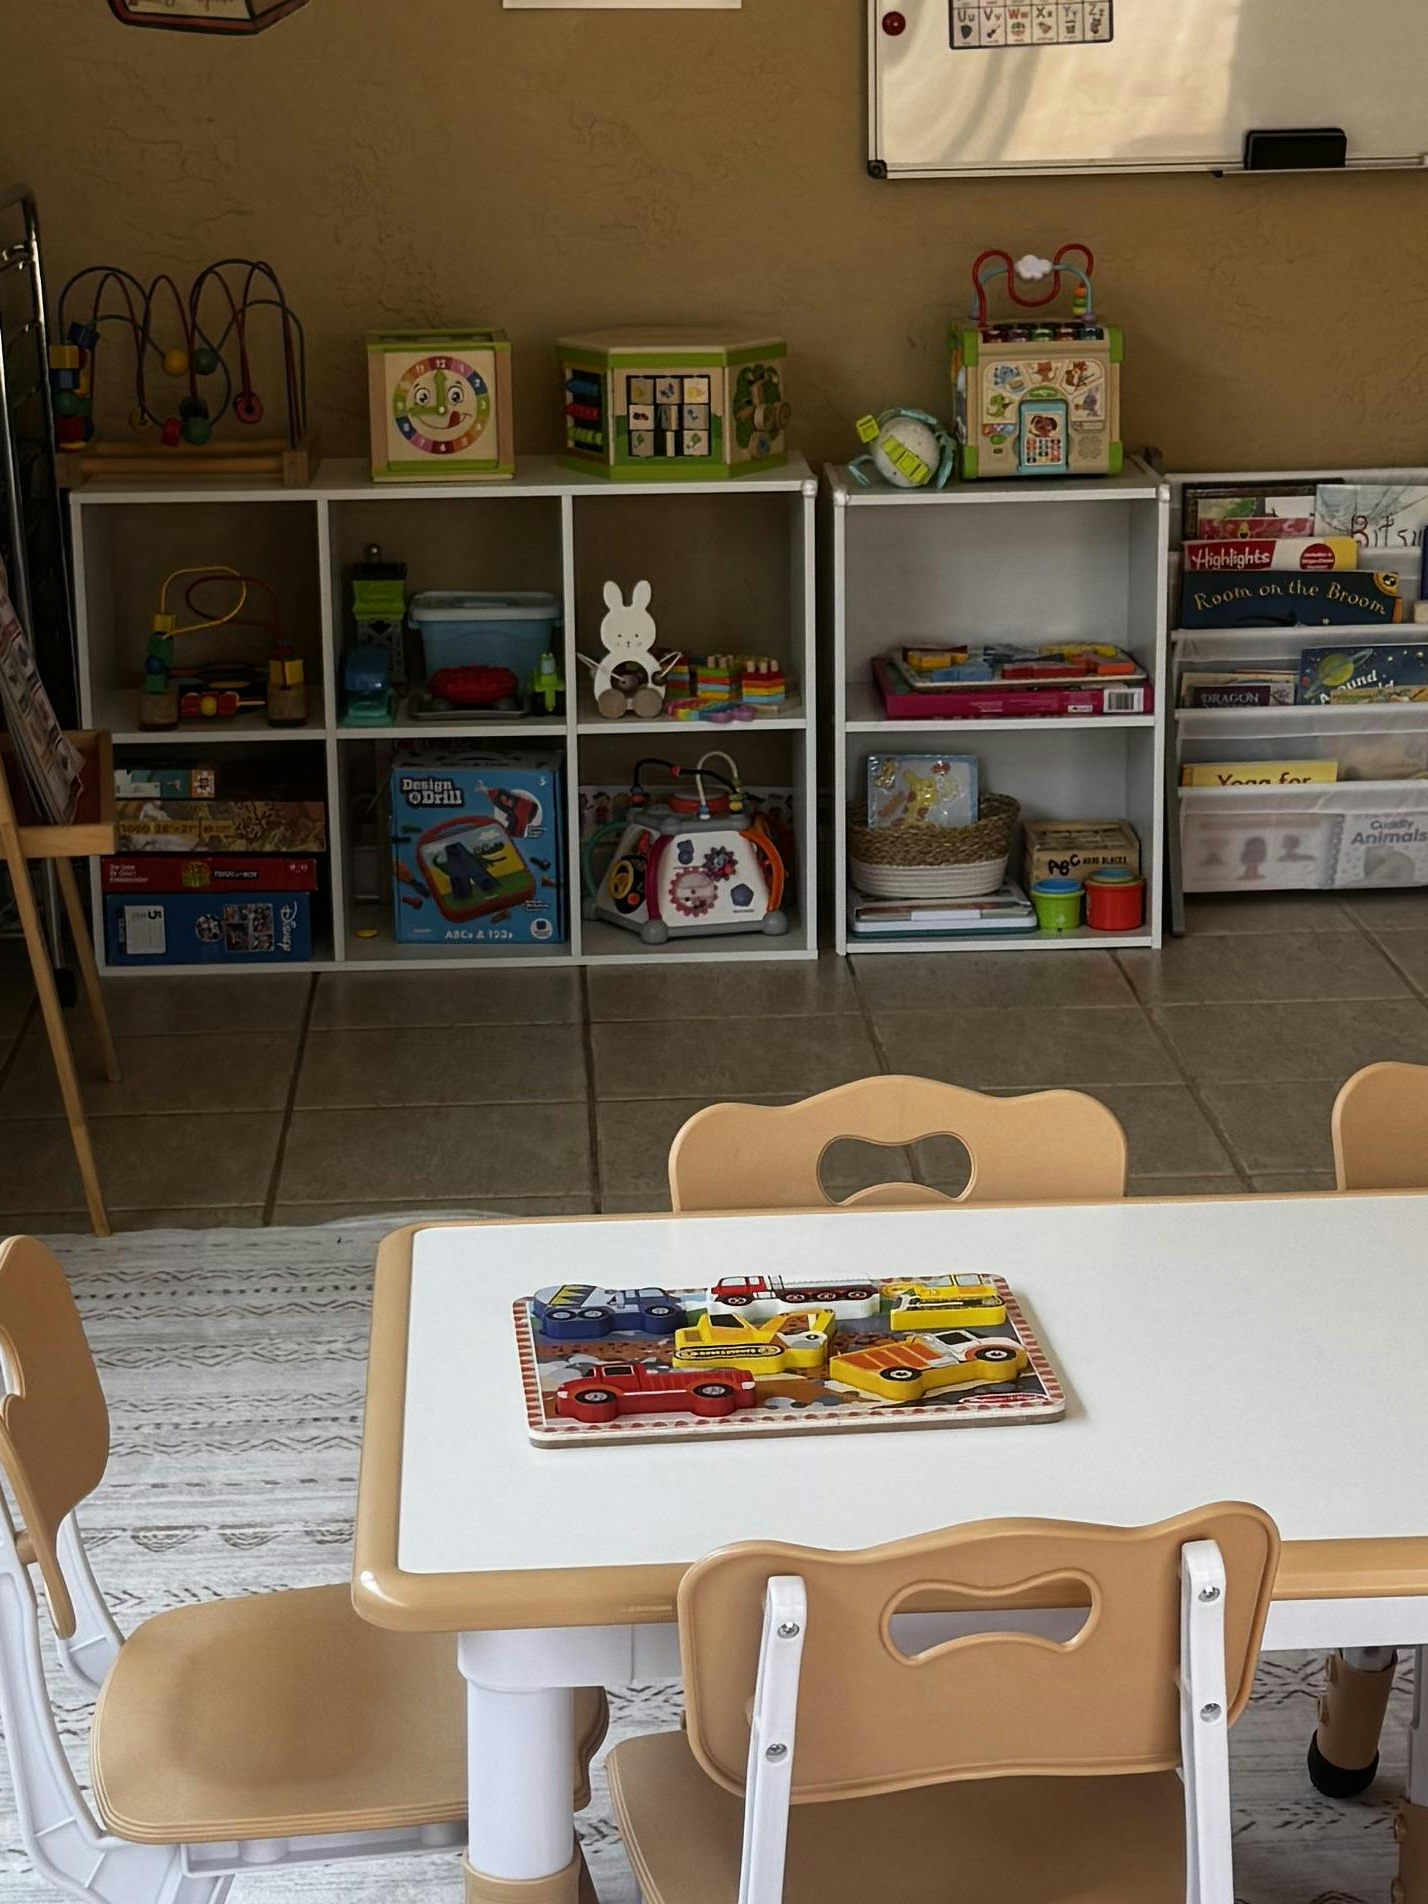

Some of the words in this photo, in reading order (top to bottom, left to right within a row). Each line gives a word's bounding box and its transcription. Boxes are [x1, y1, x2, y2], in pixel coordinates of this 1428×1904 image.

[1192, 547, 1271, 569] Highlights
[1194, 587, 1252, 611] Room
[1260, 583, 1283, 596] on
[1289, 580, 1319, 596] the
[1327, 582, 1387, 615] Broom
[402, 778, 452, 792] Design
[421, 789, 462, 805] Drill
[1351, 829, 1428, 845] Animals
[1048, 854, 1080, 876] ABC
[276, 901, 298, 952] Disney
